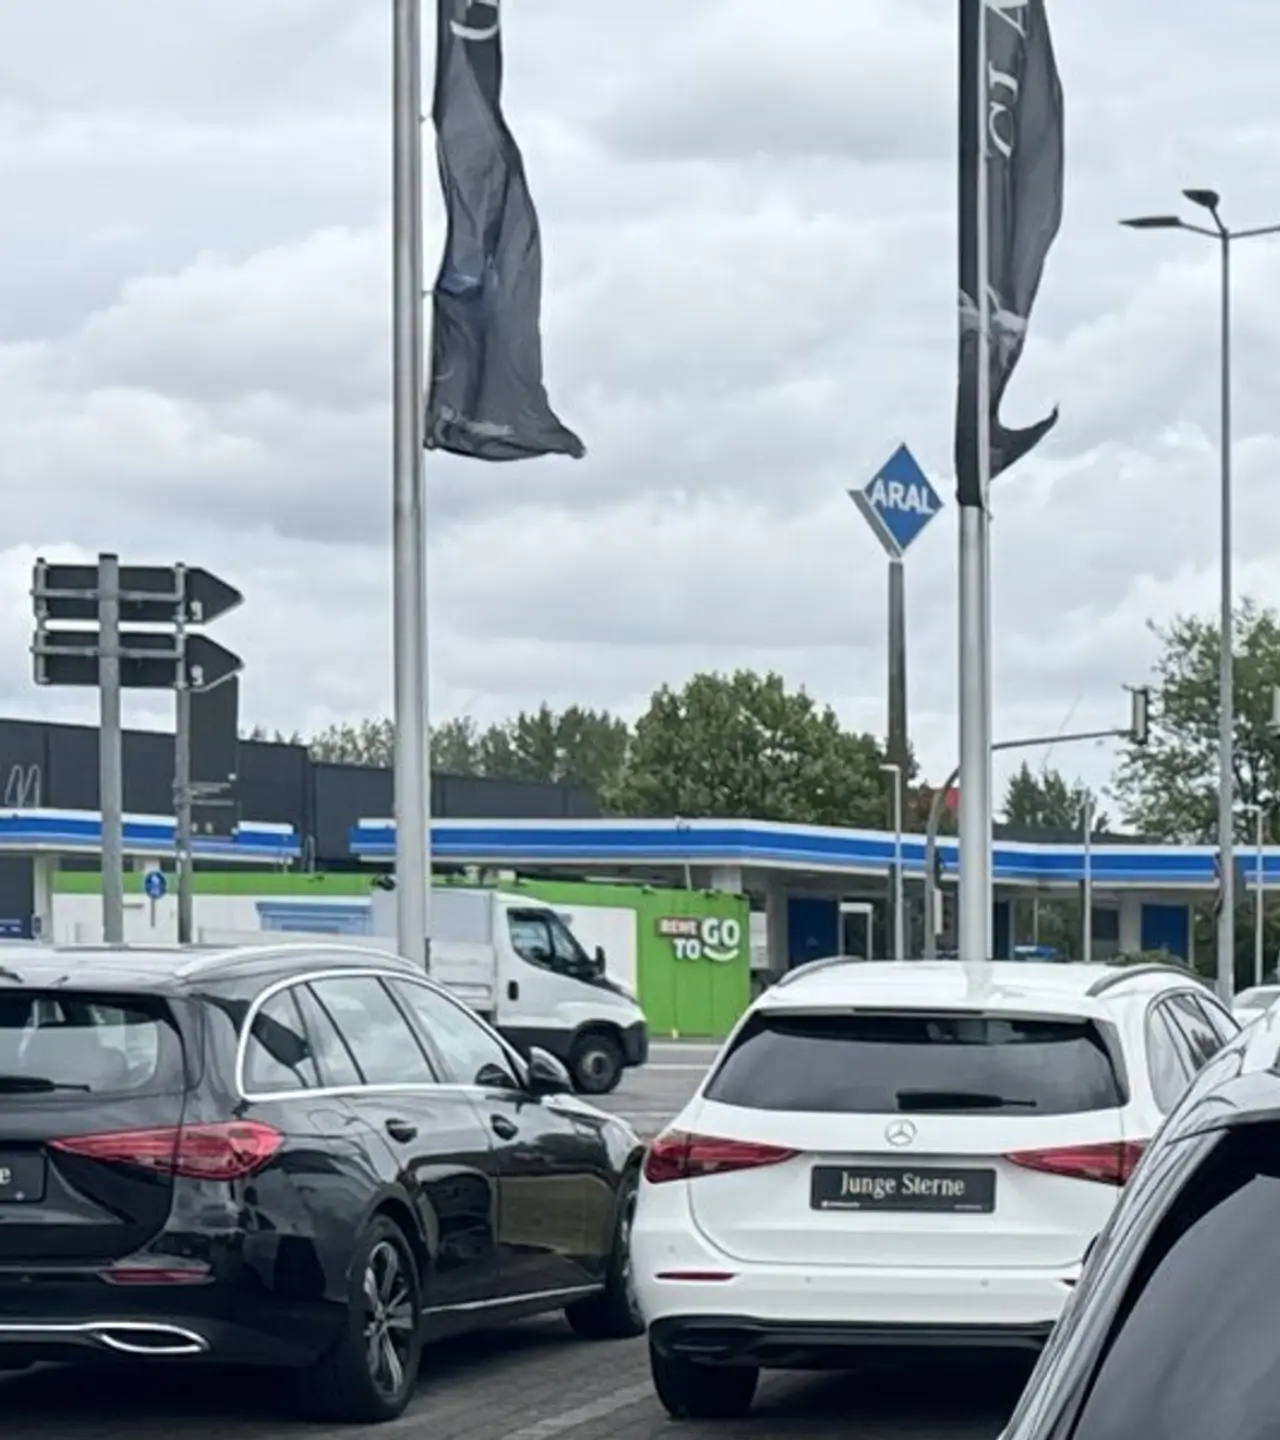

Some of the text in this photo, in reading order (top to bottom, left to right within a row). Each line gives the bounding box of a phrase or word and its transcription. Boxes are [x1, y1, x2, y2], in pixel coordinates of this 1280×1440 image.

[868, 478, 937, 516] ARAL
[701, 917, 741, 948] GO
[673, 938, 701, 960] TO
[841, 1171, 966, 1199] Junge Sterne
